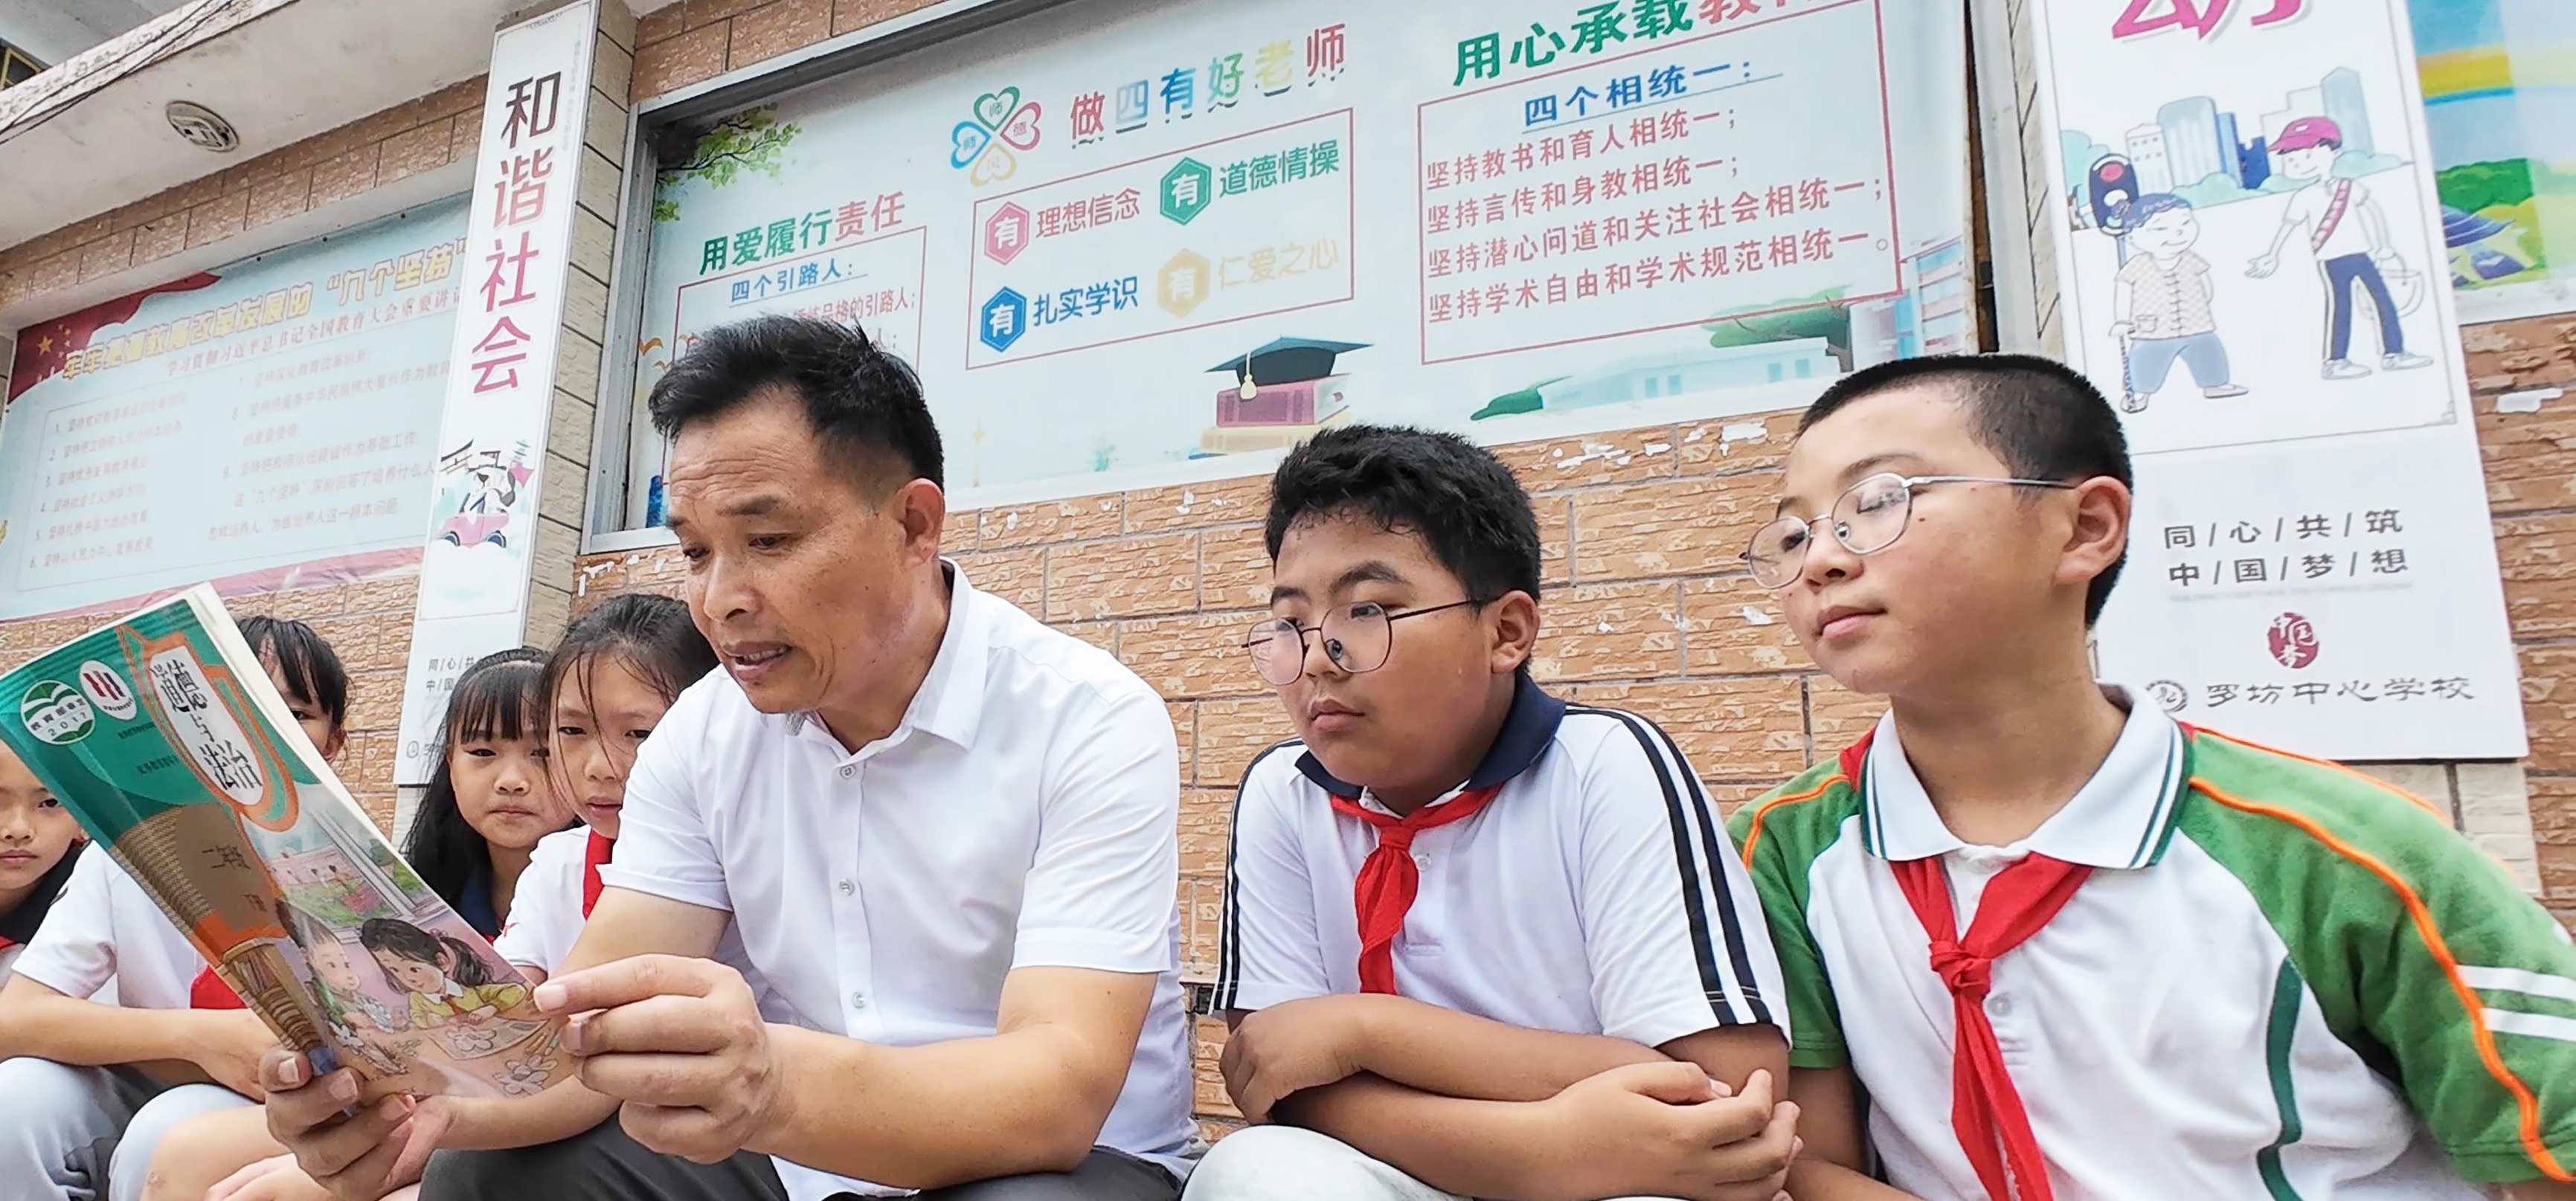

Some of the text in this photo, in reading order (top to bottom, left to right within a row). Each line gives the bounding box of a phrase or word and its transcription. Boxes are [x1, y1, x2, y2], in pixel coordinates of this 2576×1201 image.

[1453, 0, 1787, 86] 用心承载
[1070, 23, 1346, 141] 做四有好老师
[1525, 61, 1750, 127] 四个相统一：
[1171, 139, 1340, 207] 有 道德情操
[1427, 108, 1735, 190] 坚持教书和育人相统一；
[995, 189, 1140, 249] 有 理想信念
[1427, 156, 1738, 234] 坚持言传和身教相统一；
[1428, 176, 1882, 278] 坚持潜心问道和关注社会相统一；
[472, 71, 562, 394] 和谐社会
[699, 191, 905, 275] 用爱履行责任
[731, 257, 854, 303] 四个引路人：
[1167, 237, 1339, 298] 有 仁爱之心
[1428, 228, 1888, 323] 坚持学术自由和学术规范相统一。
[989, 276, 1139, 335] 有 扎实学识
[2165, 509, 2403, 549] 同/心/共/筑
[2169, 550, 2407, 586] 中/国/梦/想
[48, 712, 88, 737] 2017
[2206, 677, 2476, 708] 罗坊中心学校
